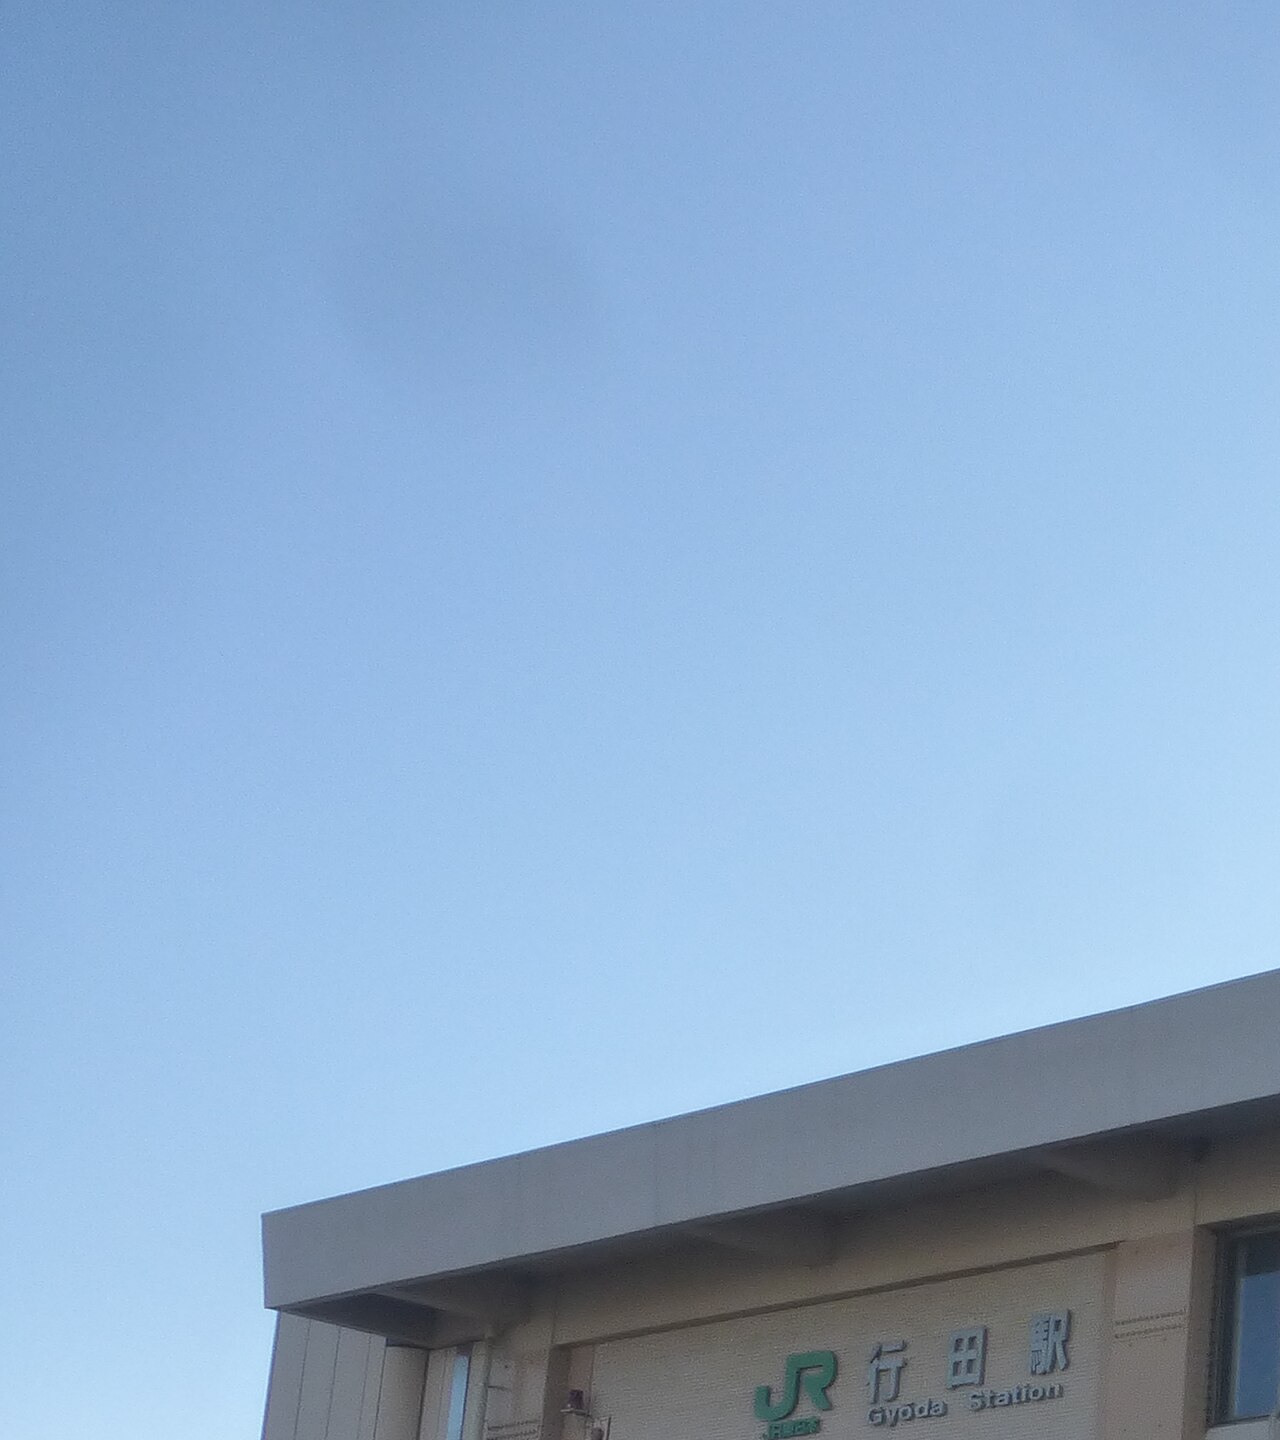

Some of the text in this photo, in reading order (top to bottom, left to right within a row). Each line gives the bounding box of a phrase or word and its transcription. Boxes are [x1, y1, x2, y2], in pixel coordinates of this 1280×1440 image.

[753, 1350, 838, 1421] JR
[868, 1309, 1071, 1404] 行田駅
[867, 1383, 1063, 1427] Gyoda Station
